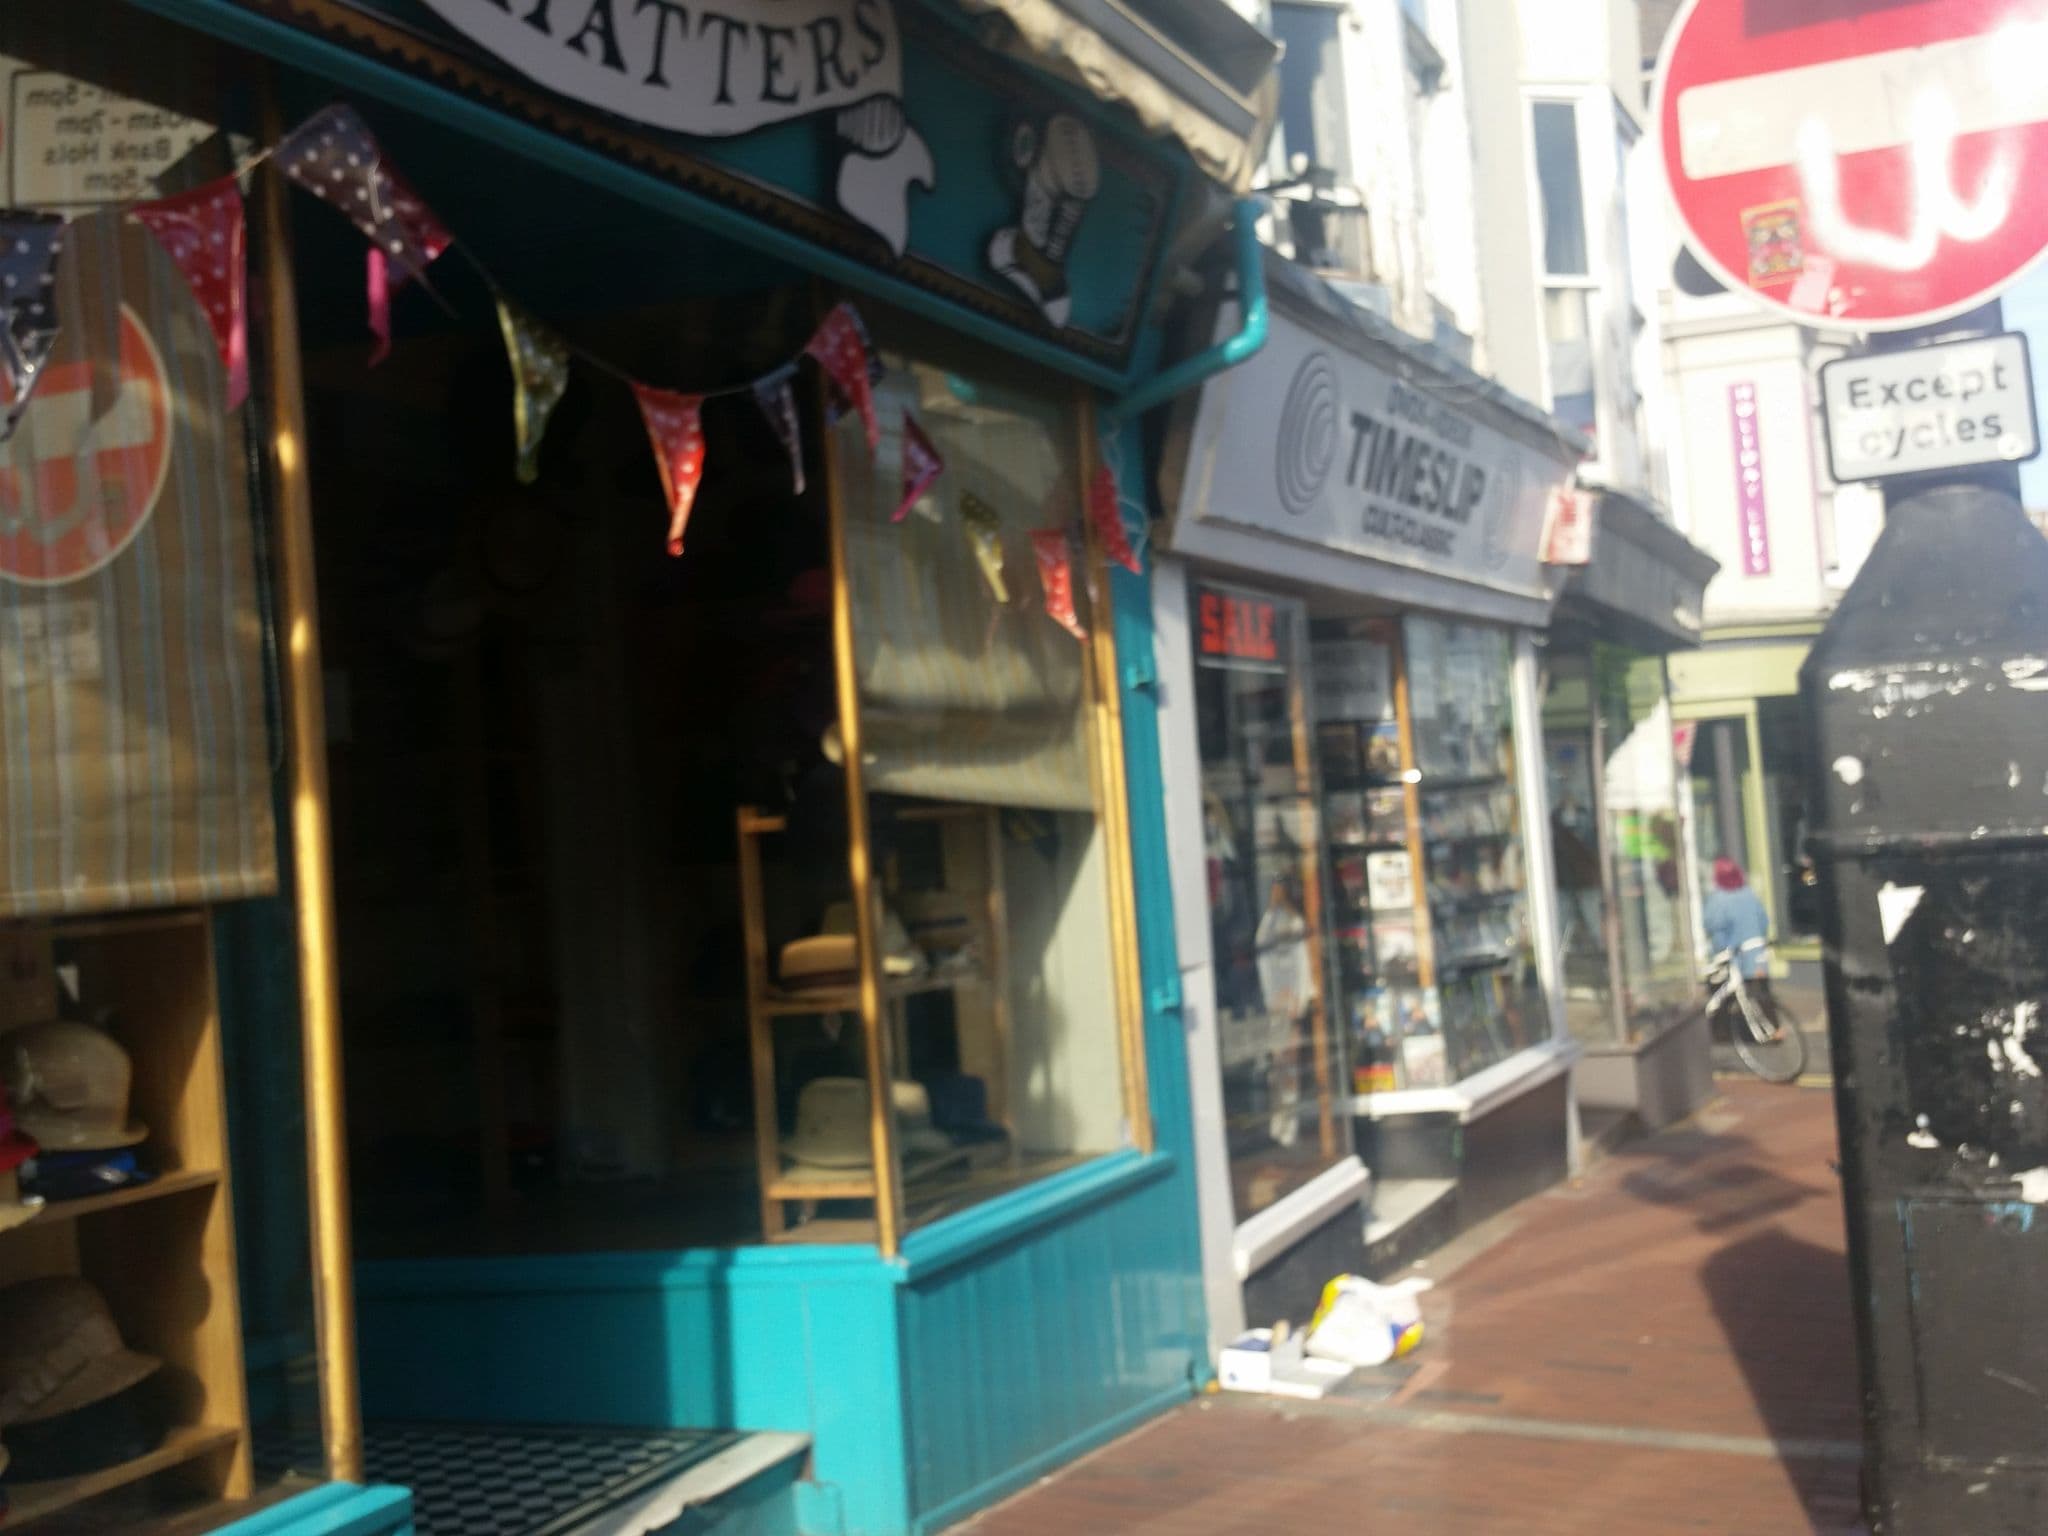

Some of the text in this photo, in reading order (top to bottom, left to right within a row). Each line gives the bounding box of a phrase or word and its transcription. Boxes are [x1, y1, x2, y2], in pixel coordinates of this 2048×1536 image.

[487, 0, 889, 106] ATTERS
[1848, 359, 2008, 409] Except
[1346, 411, 1486, 525] TIMESLIP
[1859, 412, 2003, 459] cycles
[1201, 592, 1278, 661] SALE
